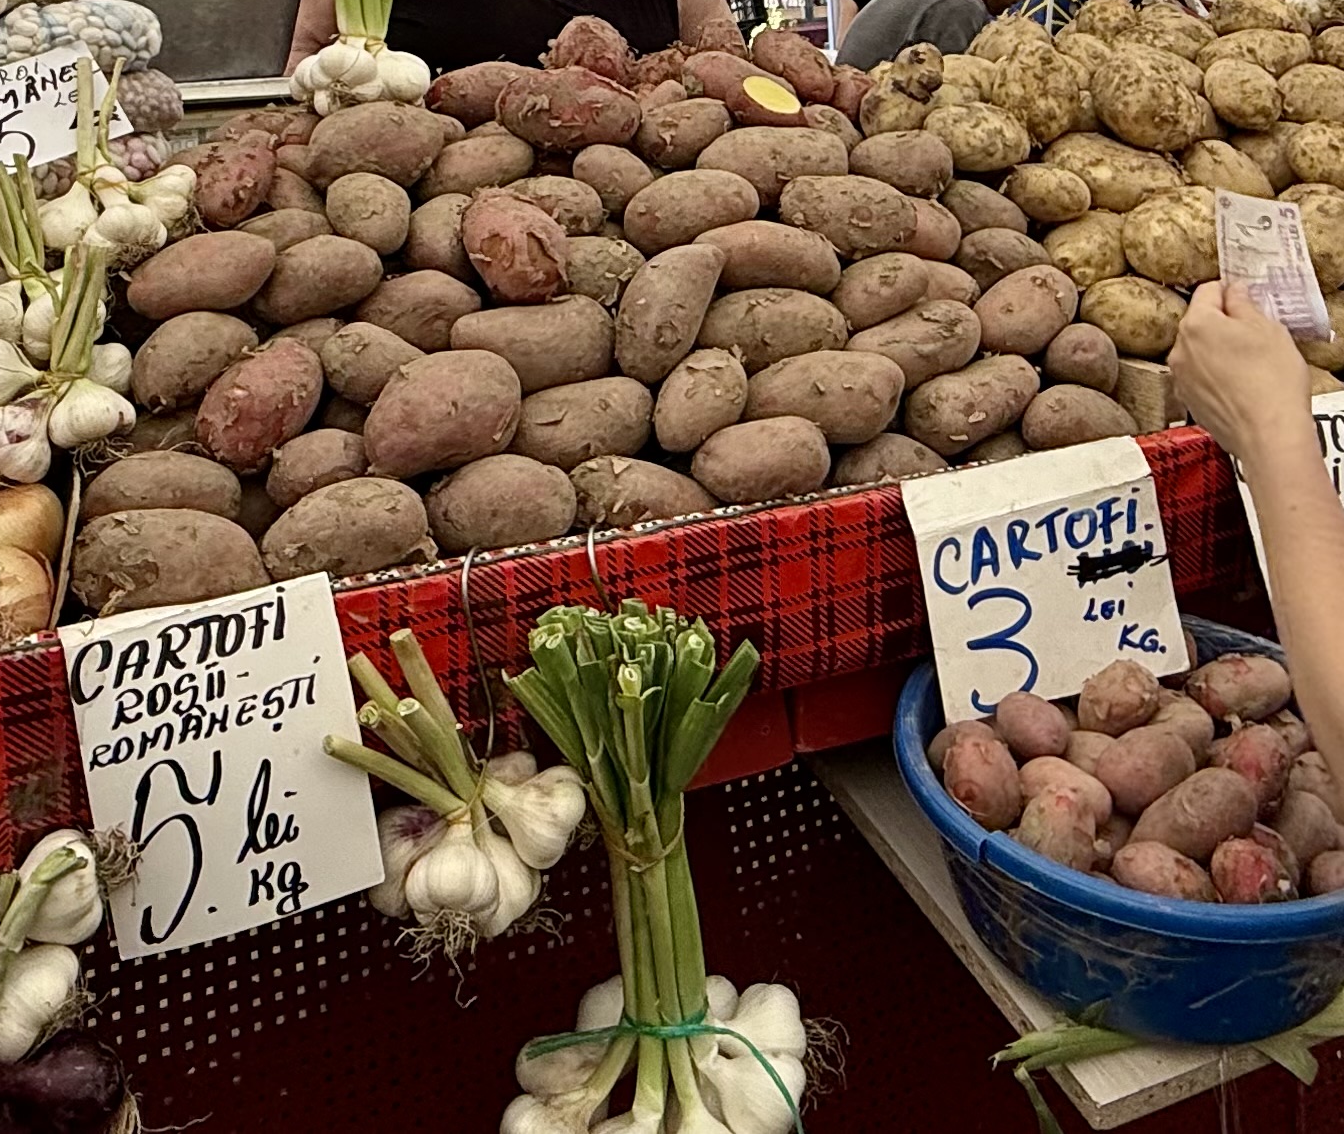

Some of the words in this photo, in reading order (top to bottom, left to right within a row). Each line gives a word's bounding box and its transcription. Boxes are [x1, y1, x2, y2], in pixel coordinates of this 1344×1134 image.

[54, 90, 78, 107] LE
[933, 487, 1141, 595] CARTOFI
[70, 586, 286, 706] CARTOFI
[967, 587, 1038, 713] 3
[1083, 590, 1128, 622] LEI
[236, 758, 300, 864] lei
